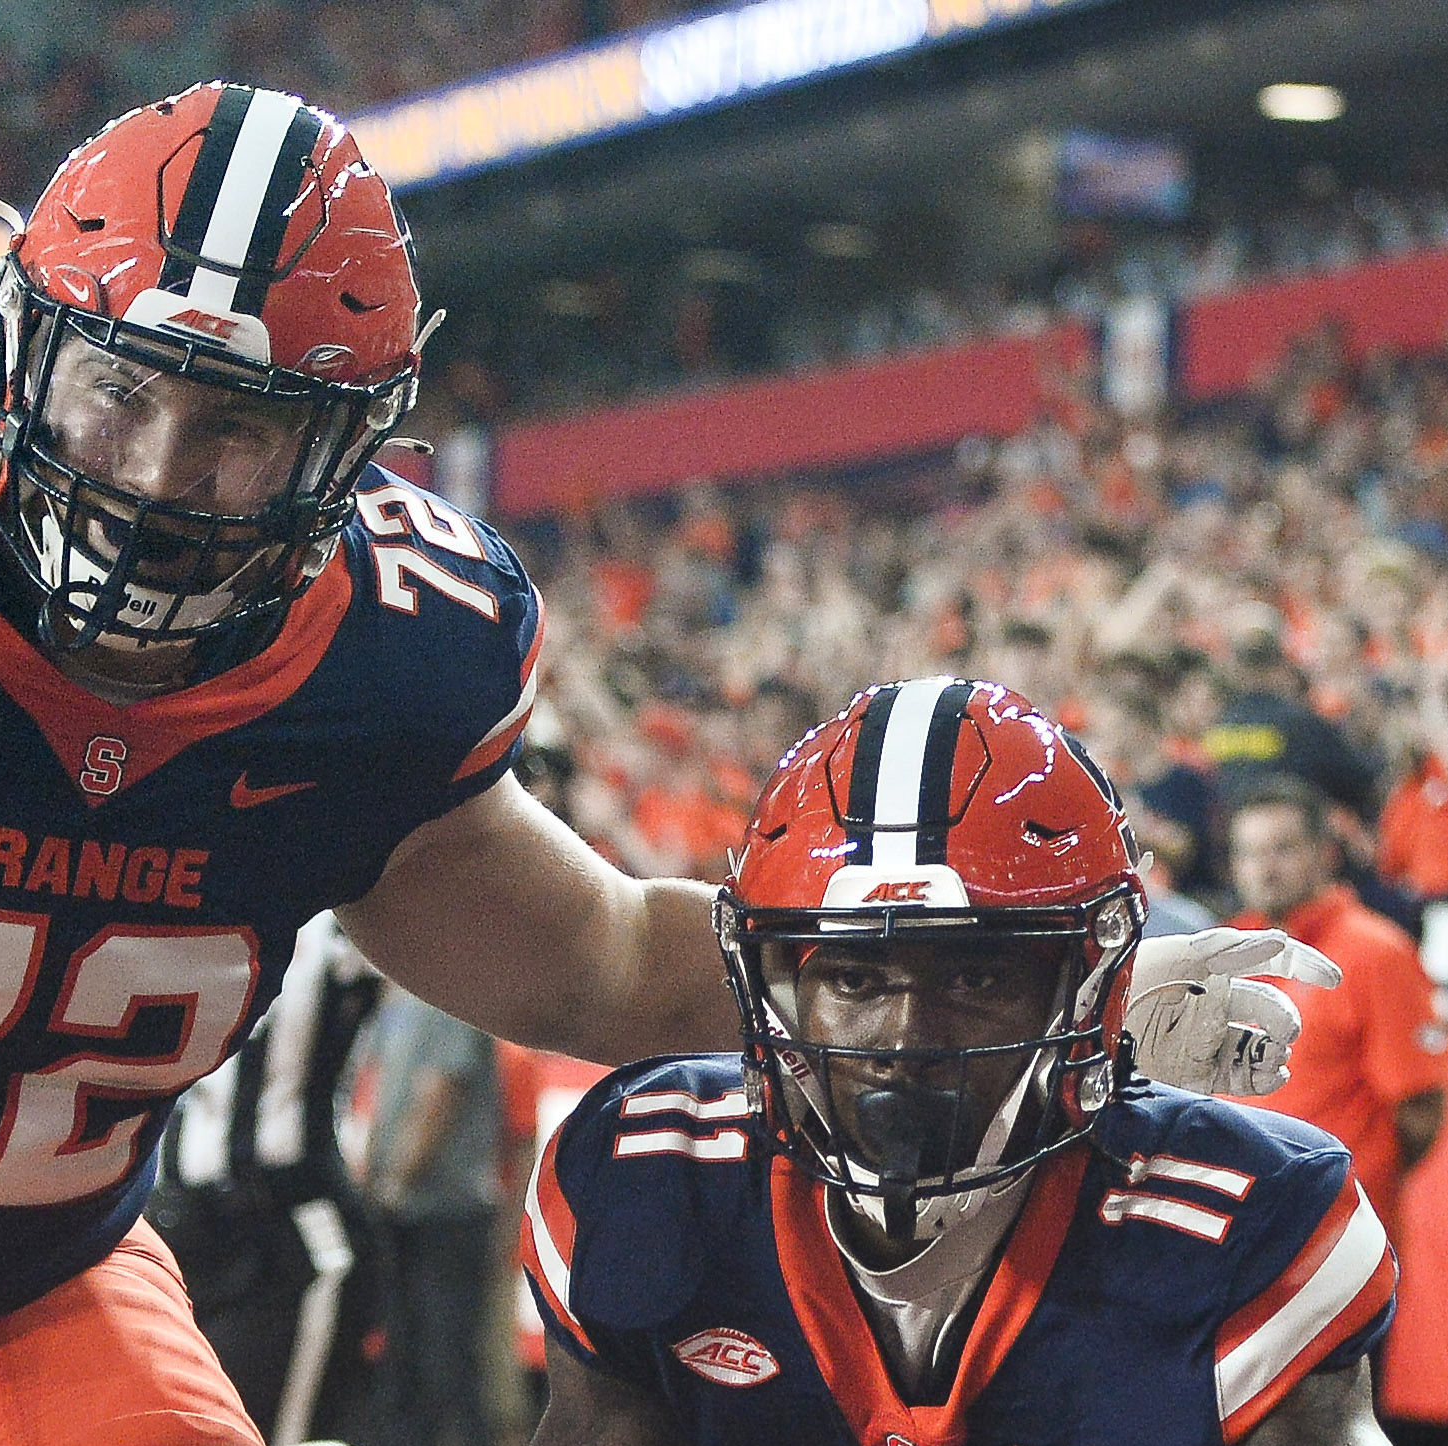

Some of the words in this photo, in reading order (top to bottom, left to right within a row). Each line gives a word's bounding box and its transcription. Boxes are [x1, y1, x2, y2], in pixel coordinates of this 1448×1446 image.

[355, 483, 500, 624] 72
[79, 736, 127, 795] S
[861, 880, 932, 902] ACC
[612, 1089, 752, 1163] 11
[1097, 1151, 1257, 1246] 11
